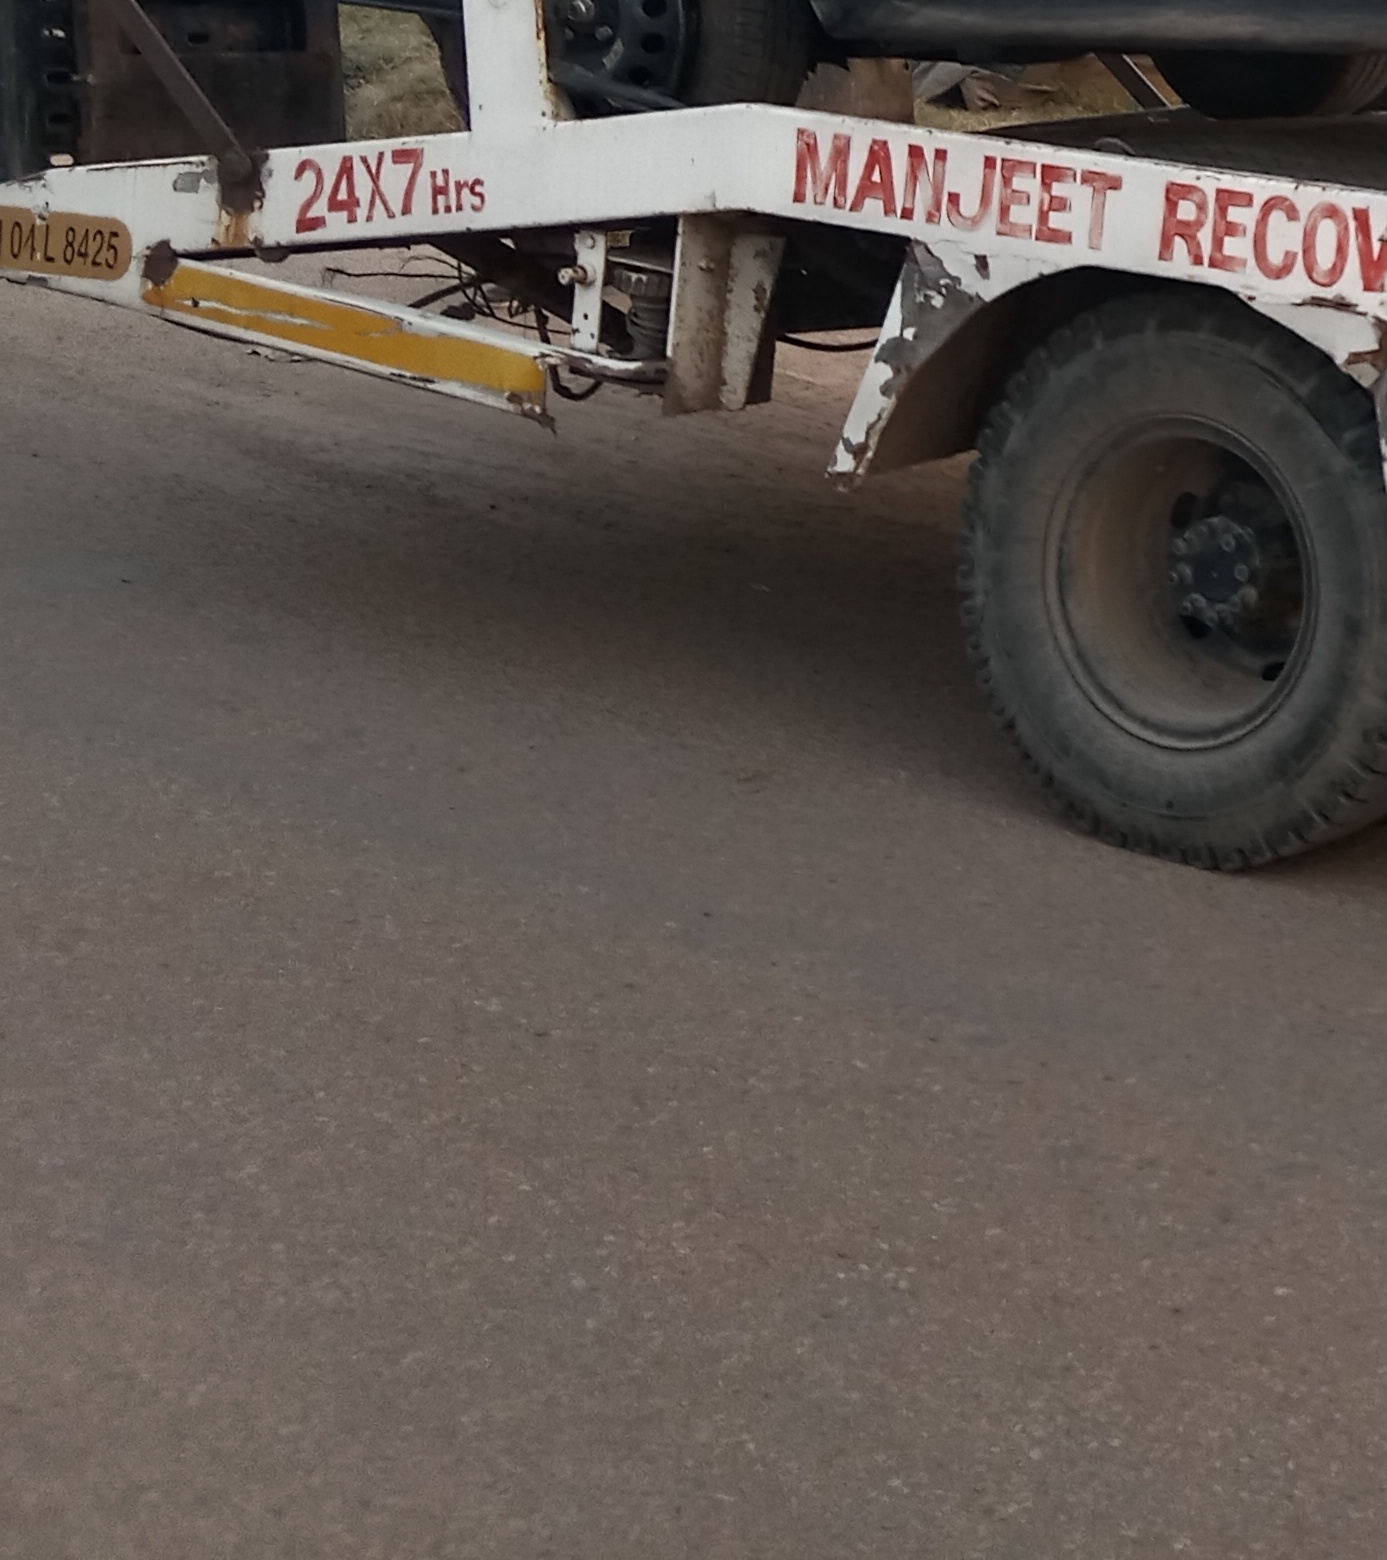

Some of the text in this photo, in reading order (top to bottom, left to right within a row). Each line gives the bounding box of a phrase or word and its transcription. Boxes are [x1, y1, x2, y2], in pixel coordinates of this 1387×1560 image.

[294, 147, 486, 234] 24X7 Hrs
[792, 127, 1123, 251] MANJEET
[63, 226, 119, 270] 8425
